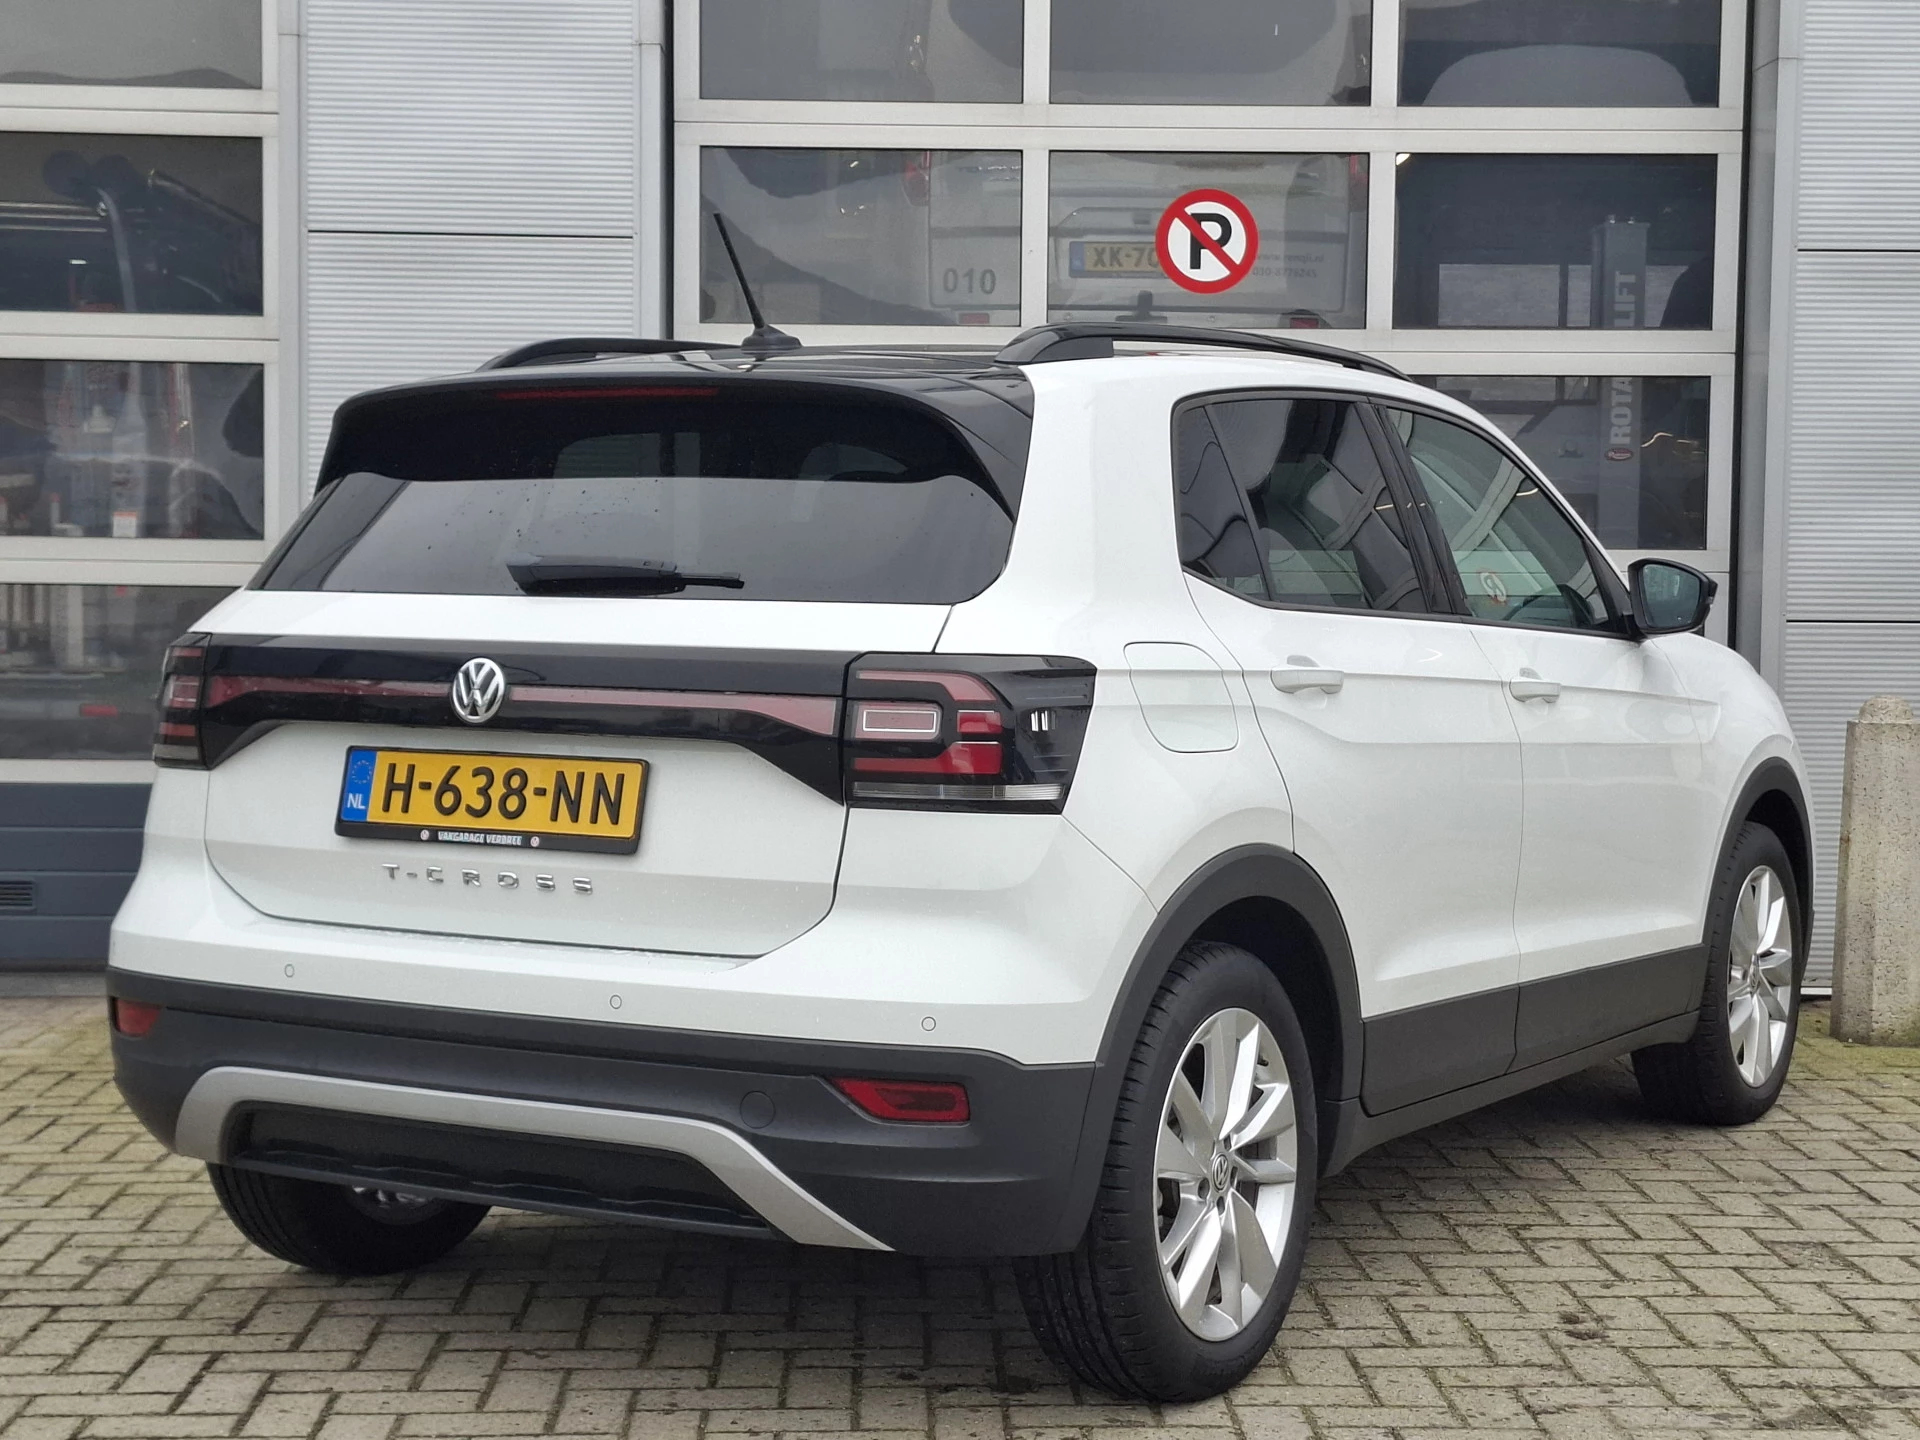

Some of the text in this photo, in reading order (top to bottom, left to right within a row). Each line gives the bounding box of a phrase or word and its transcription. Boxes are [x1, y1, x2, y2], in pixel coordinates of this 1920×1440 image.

[1093, 246, 1160, 268] XK-70
[943, 268, 996, 295] 010
[1613, 271, 1636, 328] LIFT
[1610, 376, 1632, 444] ROTA
[346, 793, 366, 809] NL
[382, 762, 625, 826] H-638-NN
[382, 863, 593, 893] T-CROSS
